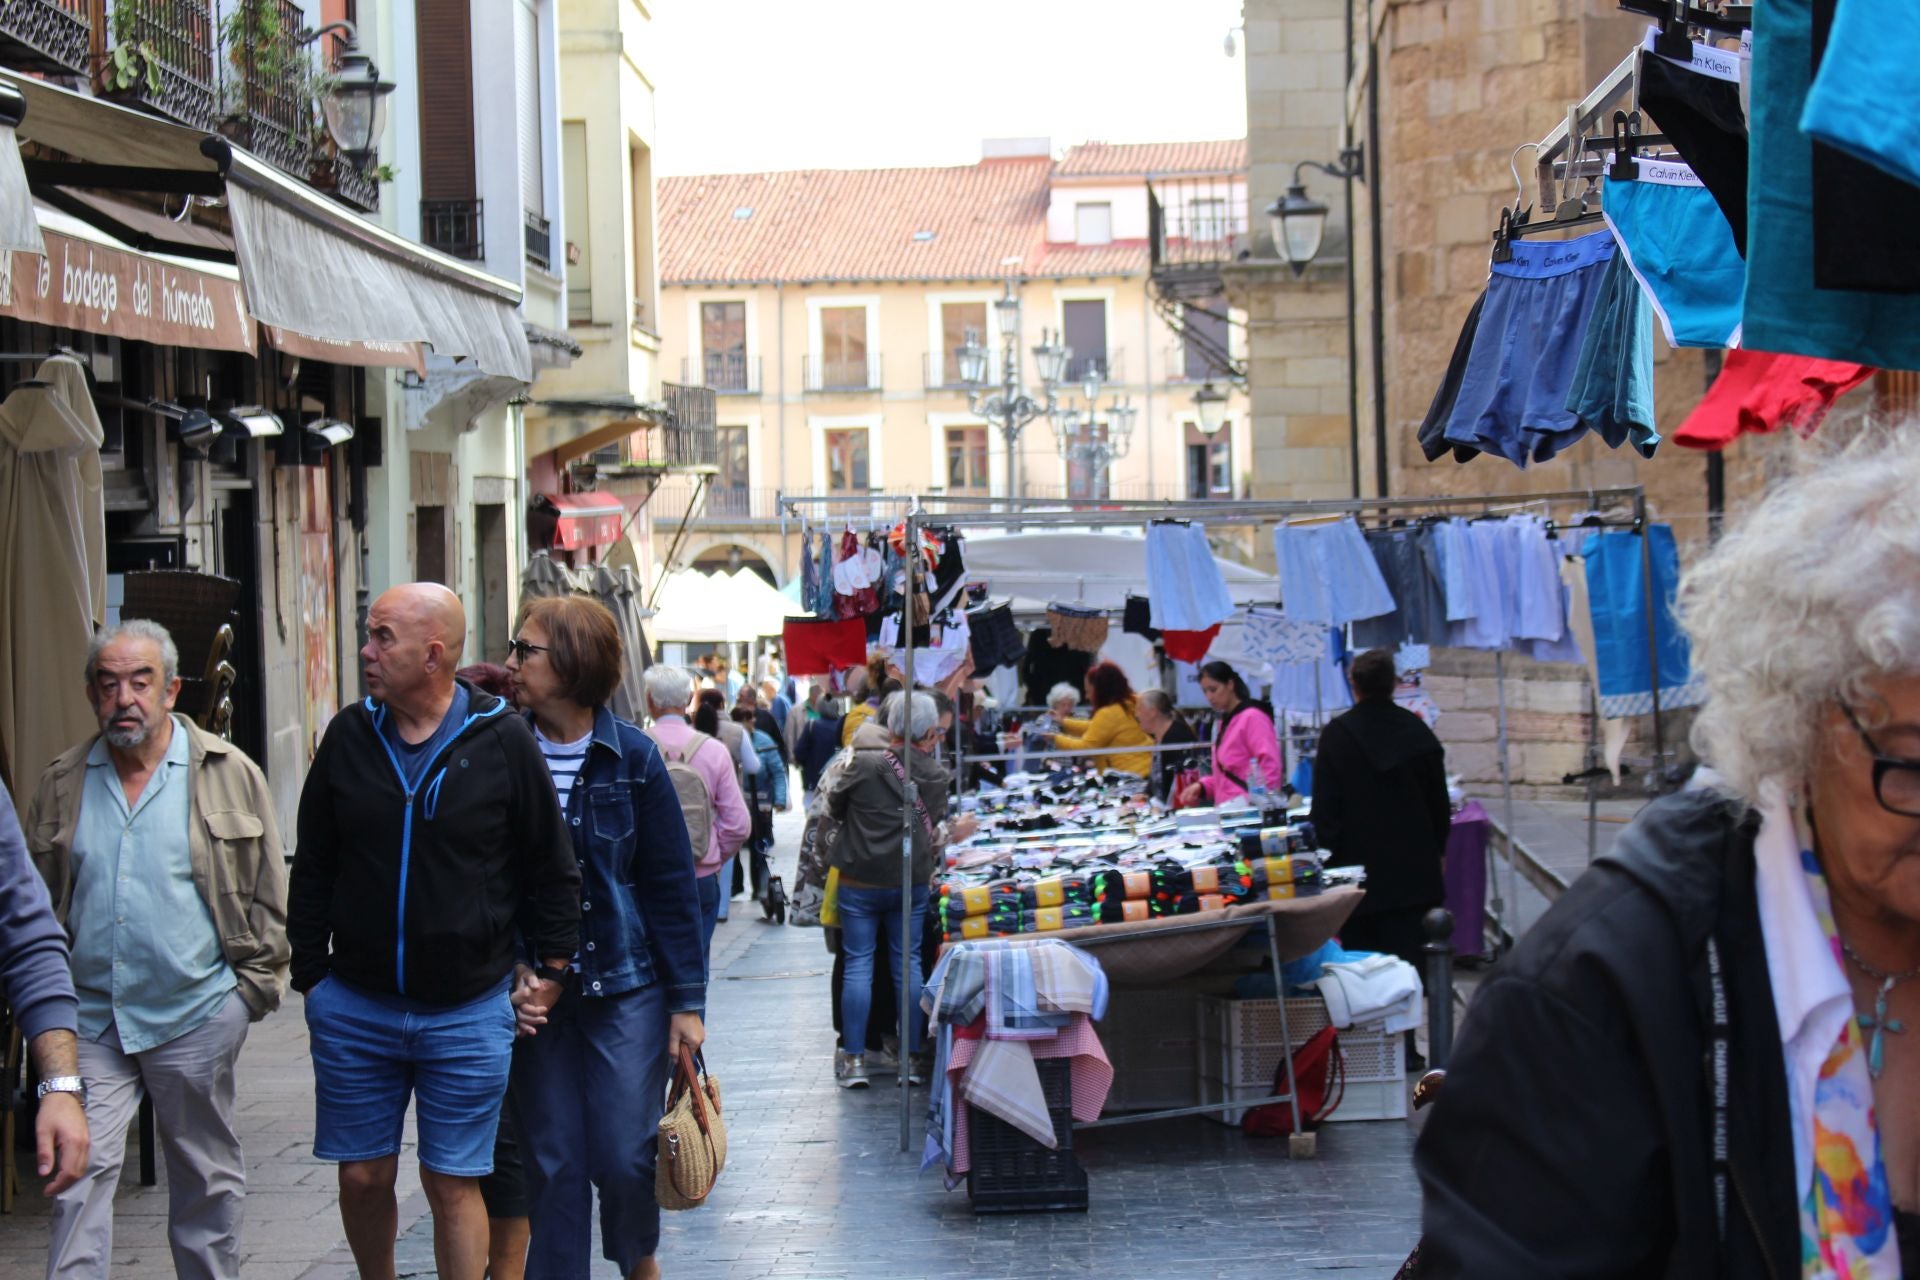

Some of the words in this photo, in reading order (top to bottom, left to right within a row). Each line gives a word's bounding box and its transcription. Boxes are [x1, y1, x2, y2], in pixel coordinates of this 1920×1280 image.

[1705, 57, 1732, 75] Klein
[1649, 166, 1677, 180] Calvin
[62, 242, 117, 325] bodega
[132, 263, 152, 318] del
[161, 267, 215, 331] húmedo
